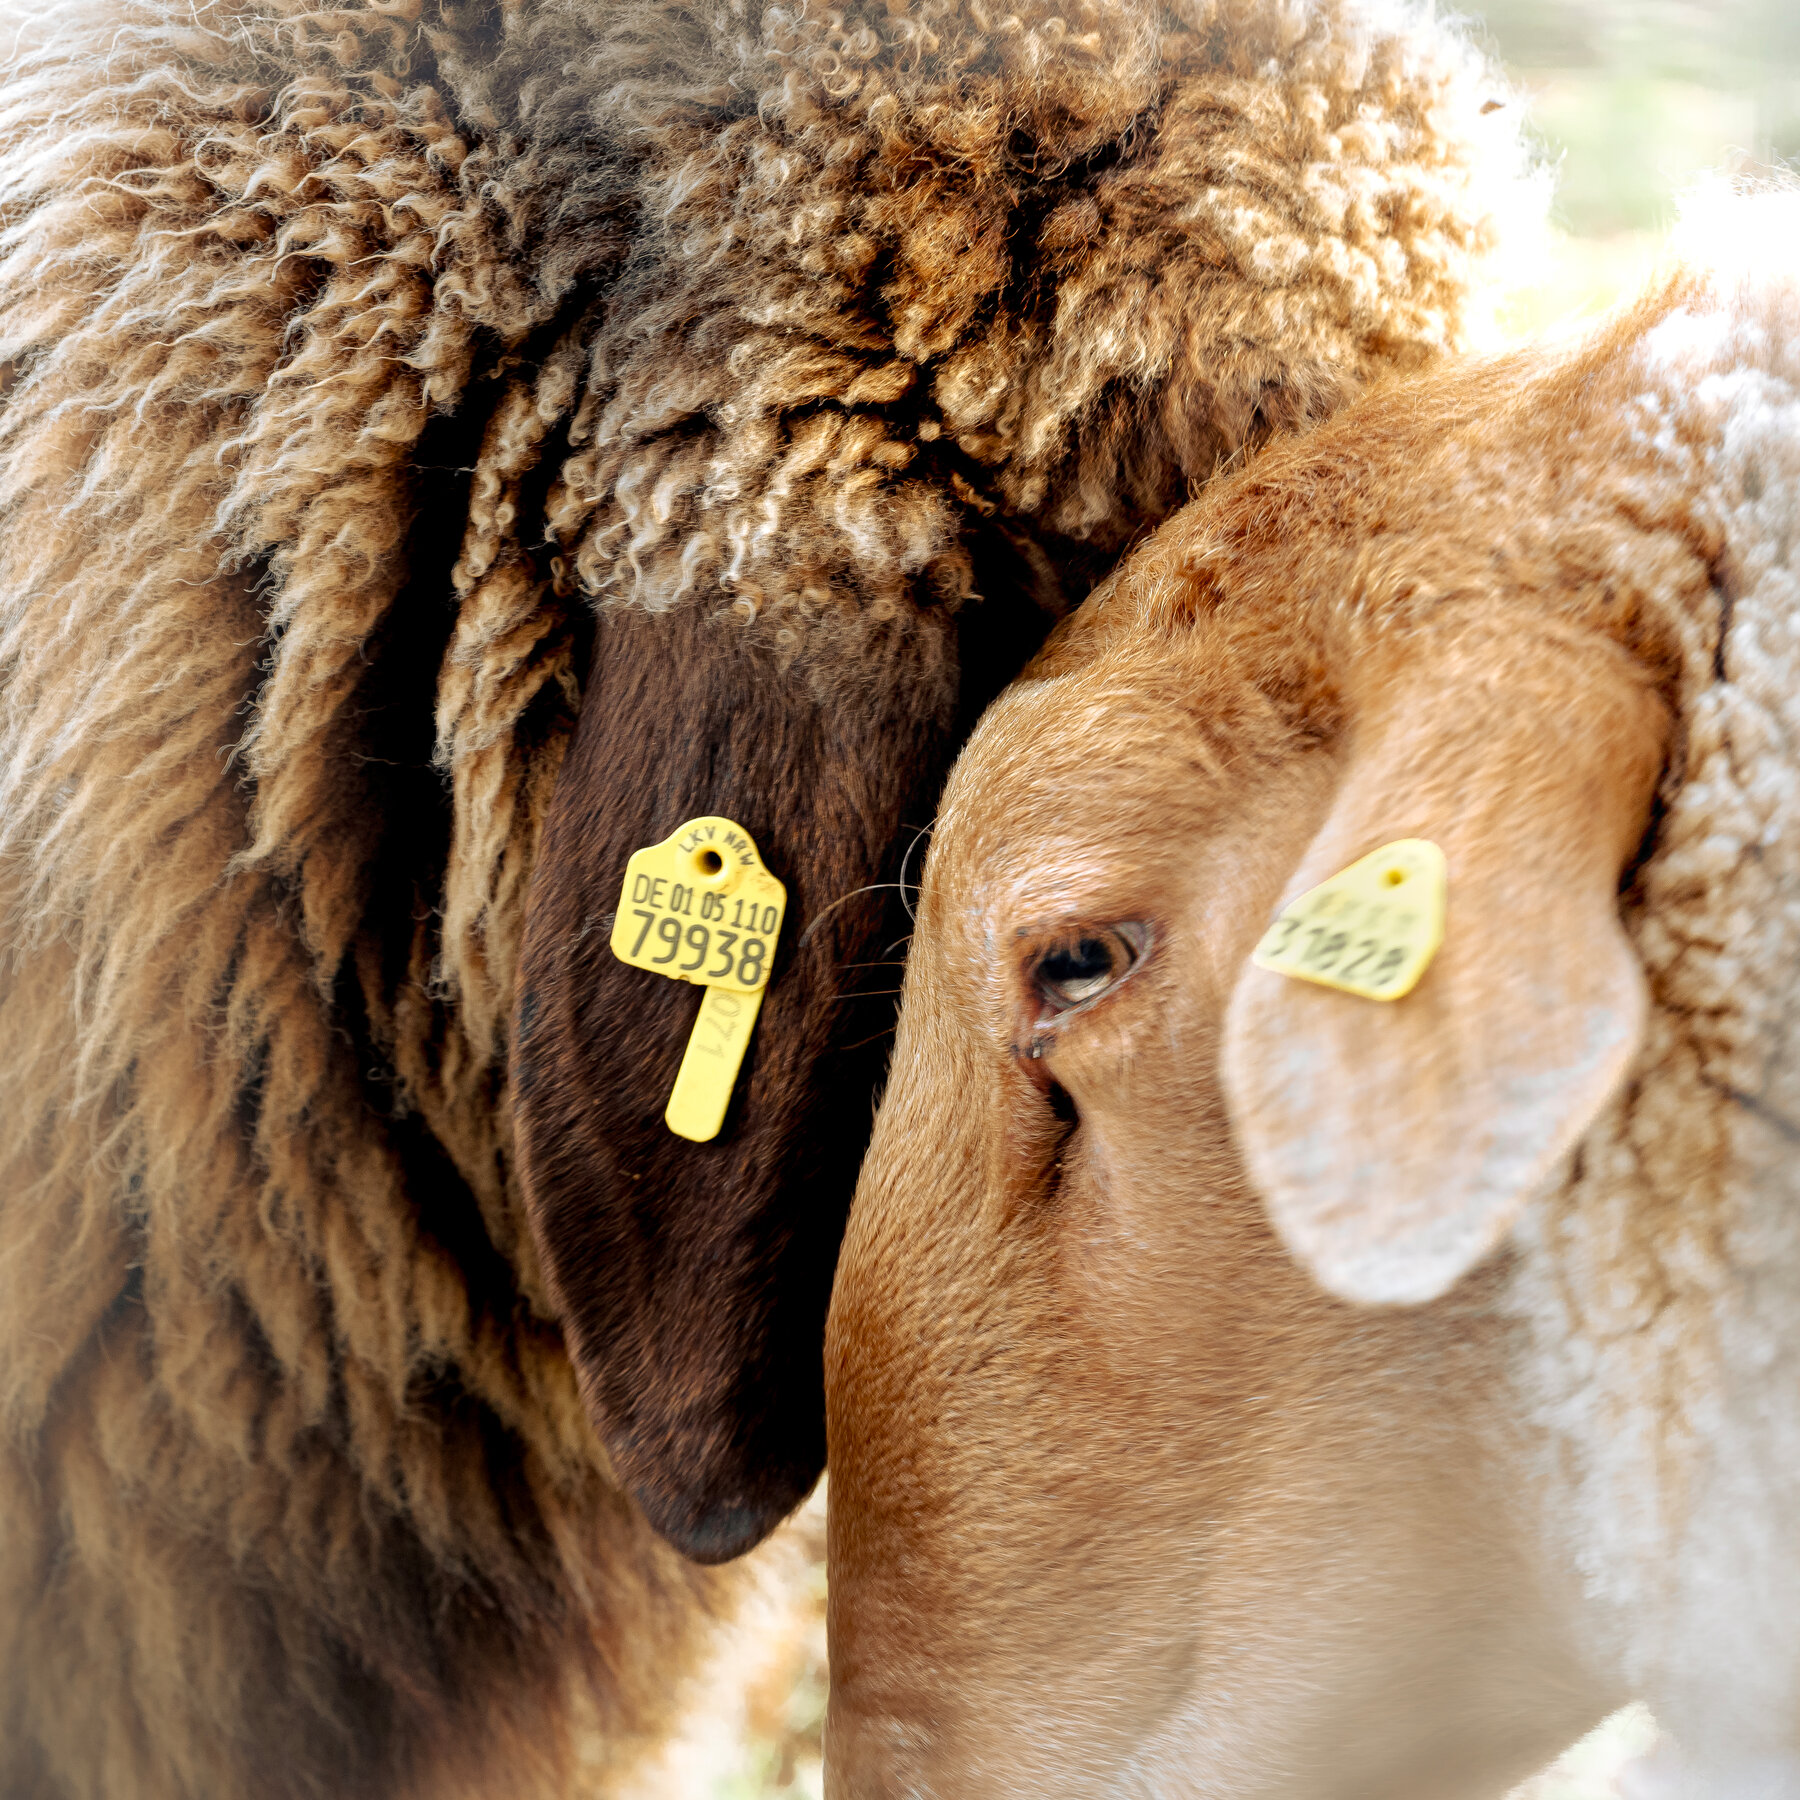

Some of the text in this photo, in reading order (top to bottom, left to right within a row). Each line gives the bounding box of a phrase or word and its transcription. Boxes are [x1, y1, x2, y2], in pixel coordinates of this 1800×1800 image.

[678, 826, 755, 866] LKV NRW
[632, 873, 778, 935] DE 01 05 110
[631, 909, 767, 986] 79938
